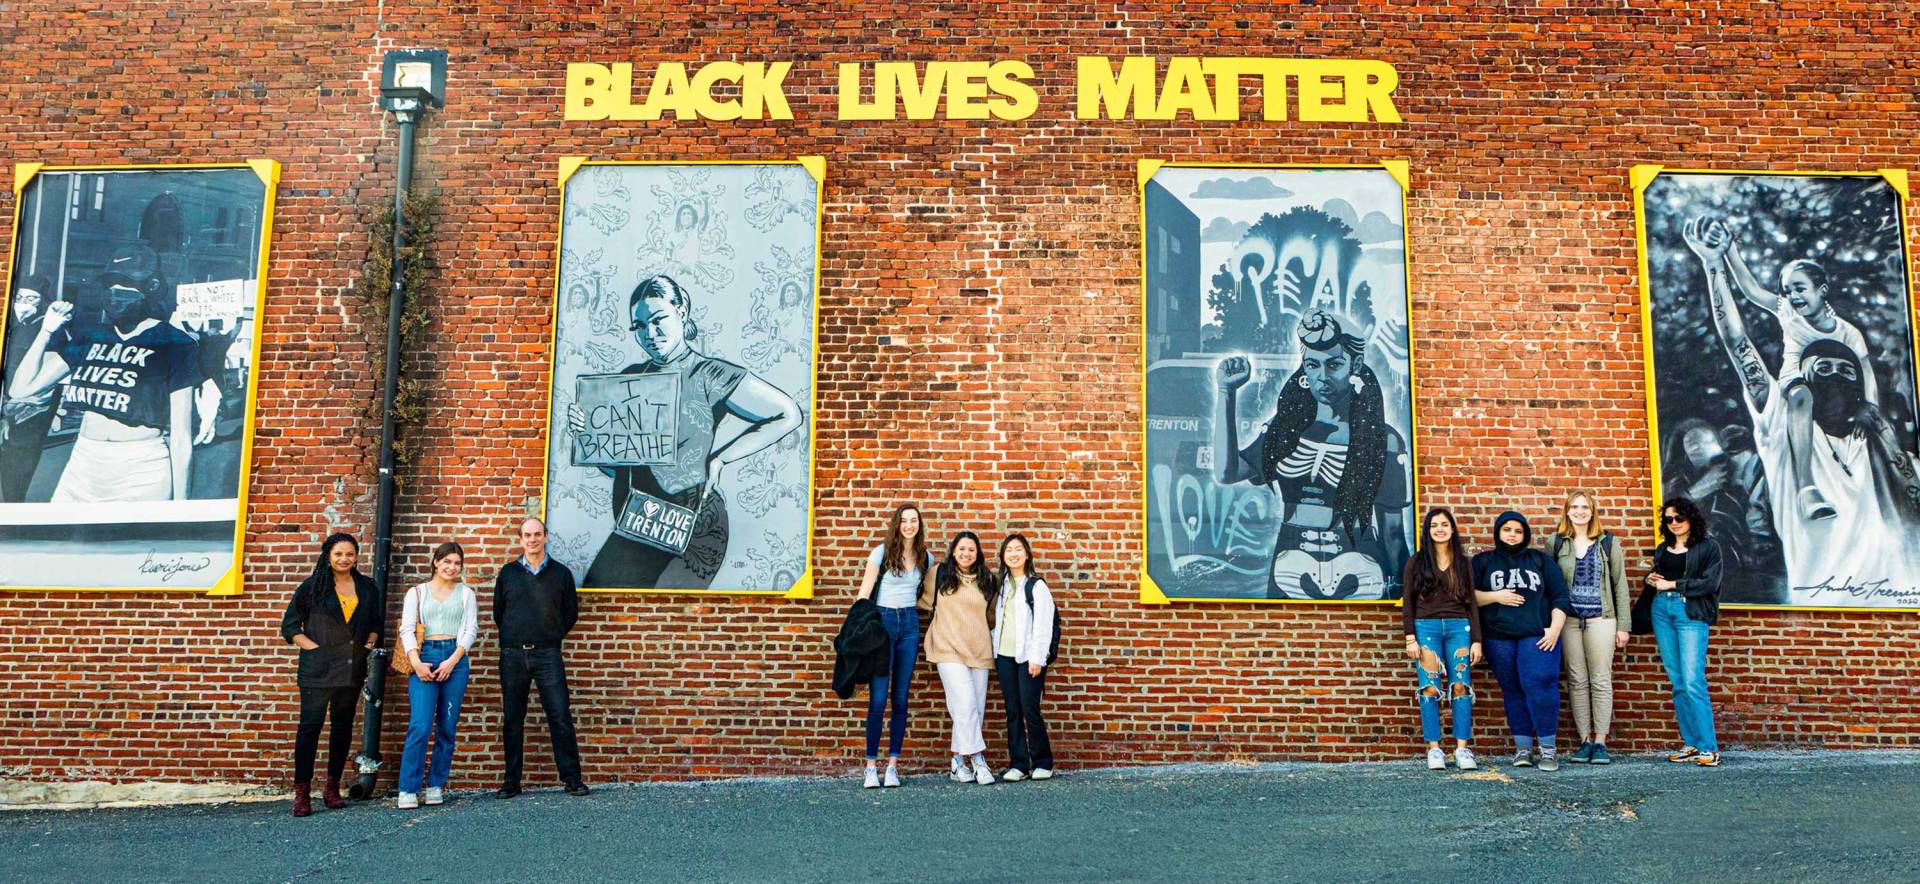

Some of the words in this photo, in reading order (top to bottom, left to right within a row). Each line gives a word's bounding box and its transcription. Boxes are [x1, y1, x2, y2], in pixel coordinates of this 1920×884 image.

[564, 61, 795, 121] BLACK
[837, 60, 1039, 121] LIVES
[1077, 56, 1402, 123] MATTER
[207, 285, 225, 294] NOT
[86, 343, 155, 367] BLACK
[72, 365, 138, 388] LIVES
[62, 385, 131, 412] MATTER
[619, 379, 641, 404] I
[590, 398, 668, 431] CAN'T
[578, 432, 673, 461] BREATHE
[624, 511, 687, 548] TRENTON
[659, 506, 693, 532] LOVE
[1152, 464, 1268, 574] LOVE
[1490, 568, 1541, 592] GAP
